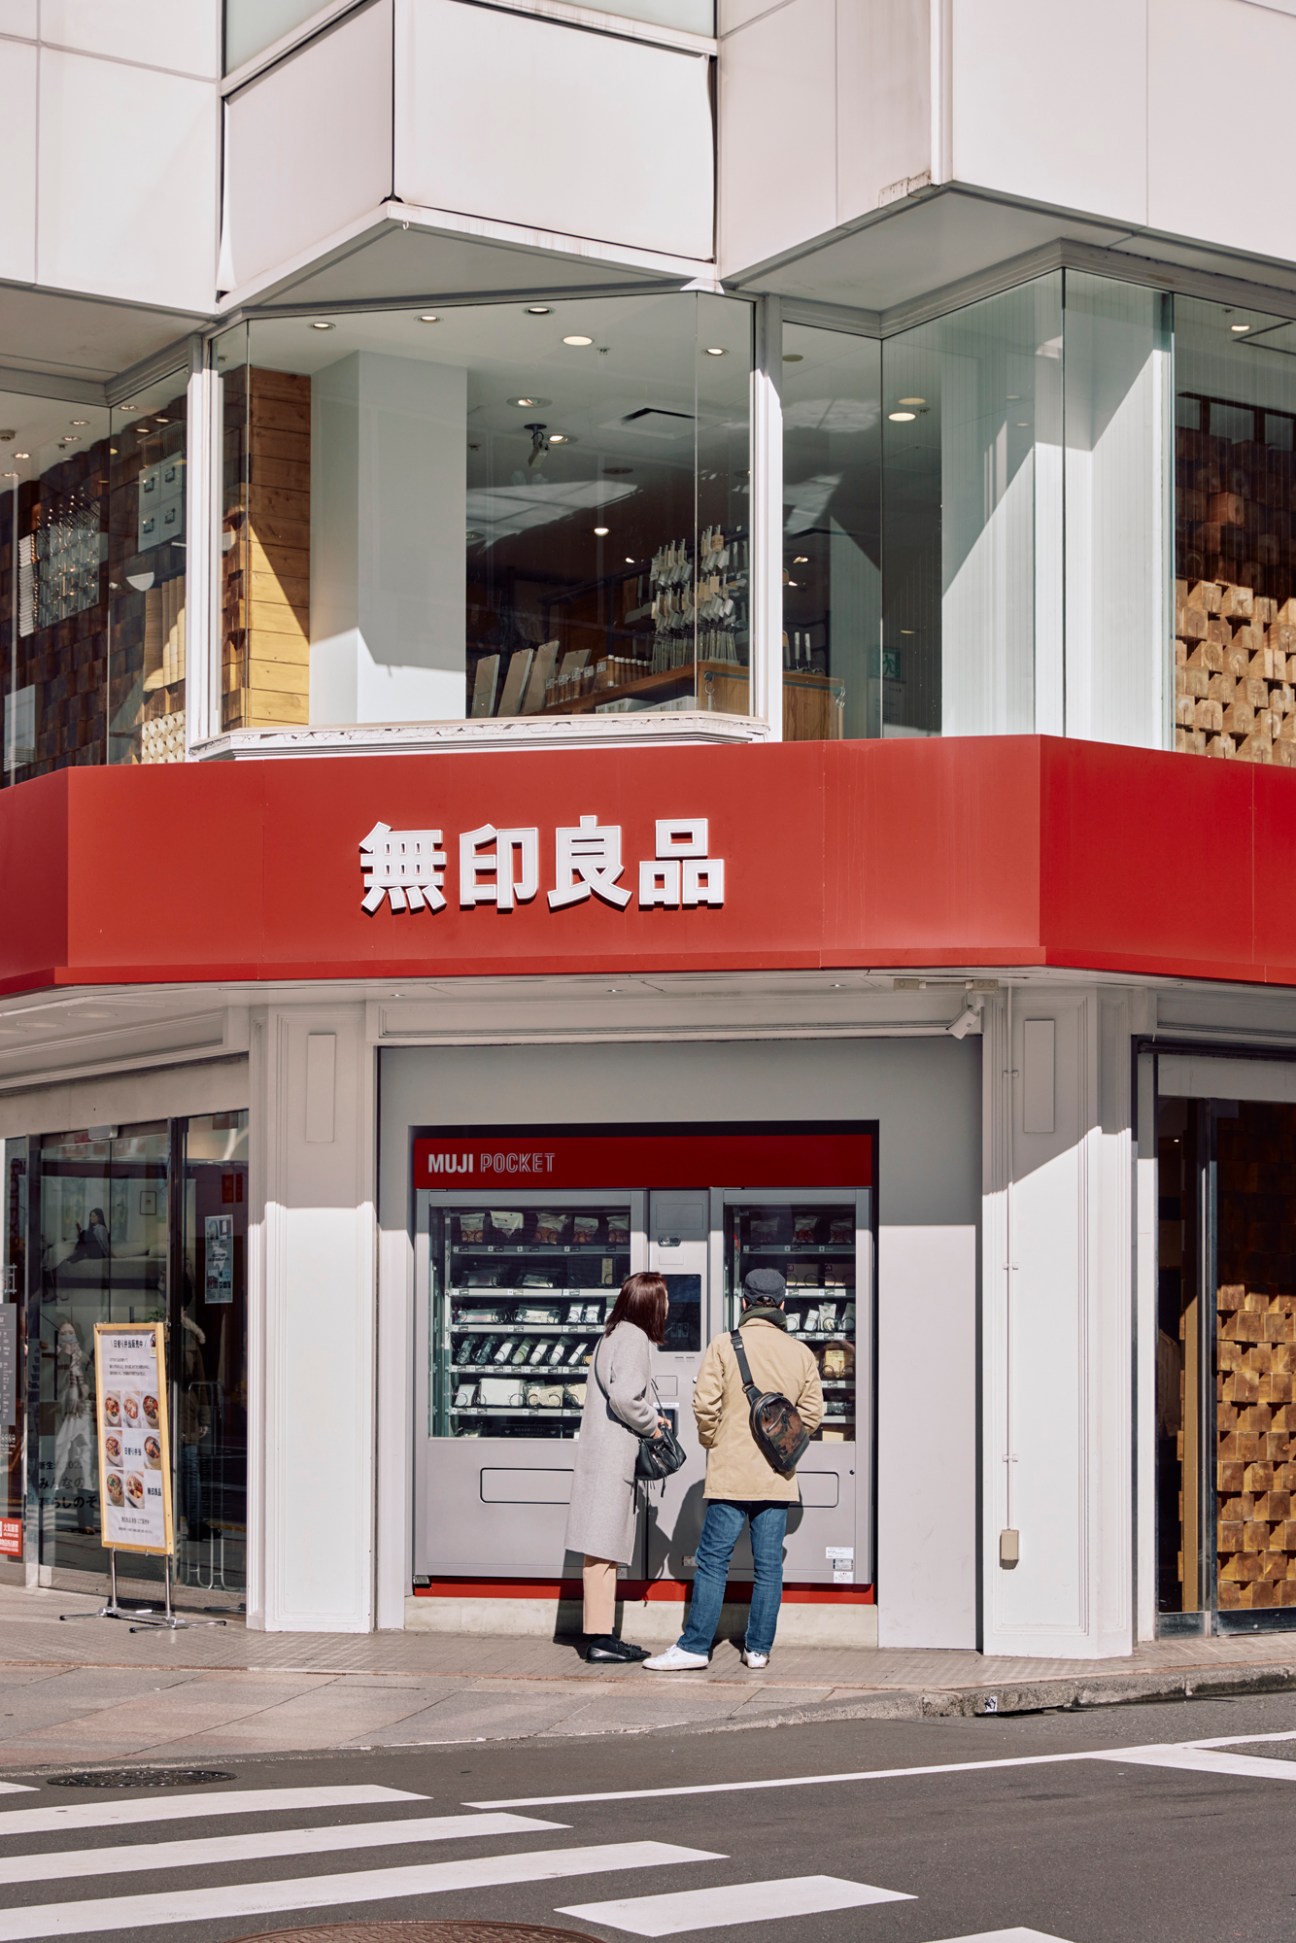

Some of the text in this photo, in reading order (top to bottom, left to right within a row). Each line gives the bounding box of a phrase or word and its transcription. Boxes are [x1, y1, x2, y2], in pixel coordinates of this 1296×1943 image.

[359, 815, 726, 914] 無印良品
[427, 1152, 556, 1174] MUJI POCKET
